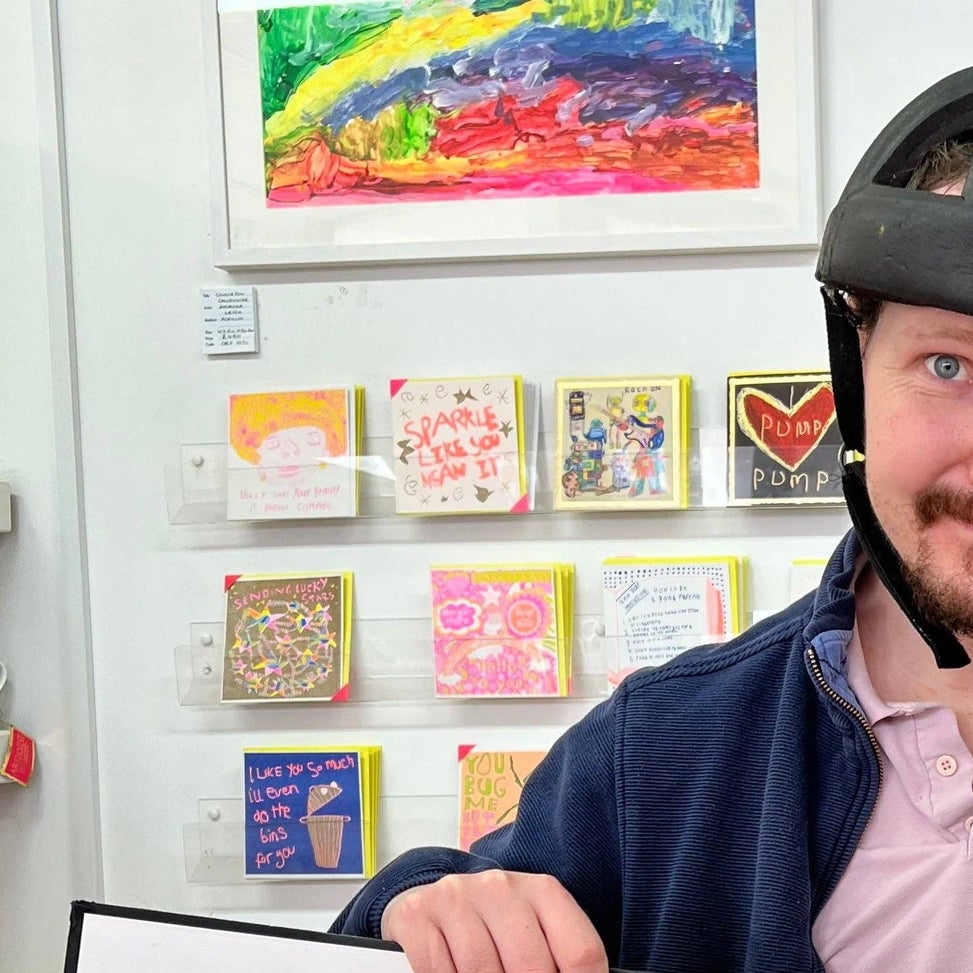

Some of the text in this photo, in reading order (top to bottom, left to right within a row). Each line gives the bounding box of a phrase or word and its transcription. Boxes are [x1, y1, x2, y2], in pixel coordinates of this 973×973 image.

[403, 405, 499, 450] SPARKLE
[418, 439, 468, 468] LIKE
[420, 455, 500, 490] MEAN IT
[233, 584, 292, 610] SENDING
[295, 577, 329, 594] LUCKY
[301, 591, 335, 605] STARS
[466, 752, 505, 776] YOU
[464, 774, 507, 798] BUG
[253, 808, 270, 824] do
[464, 796, 500, 812] ME
[259, 826, 288, 844] bins
[255, 845, 296, 869] for you
